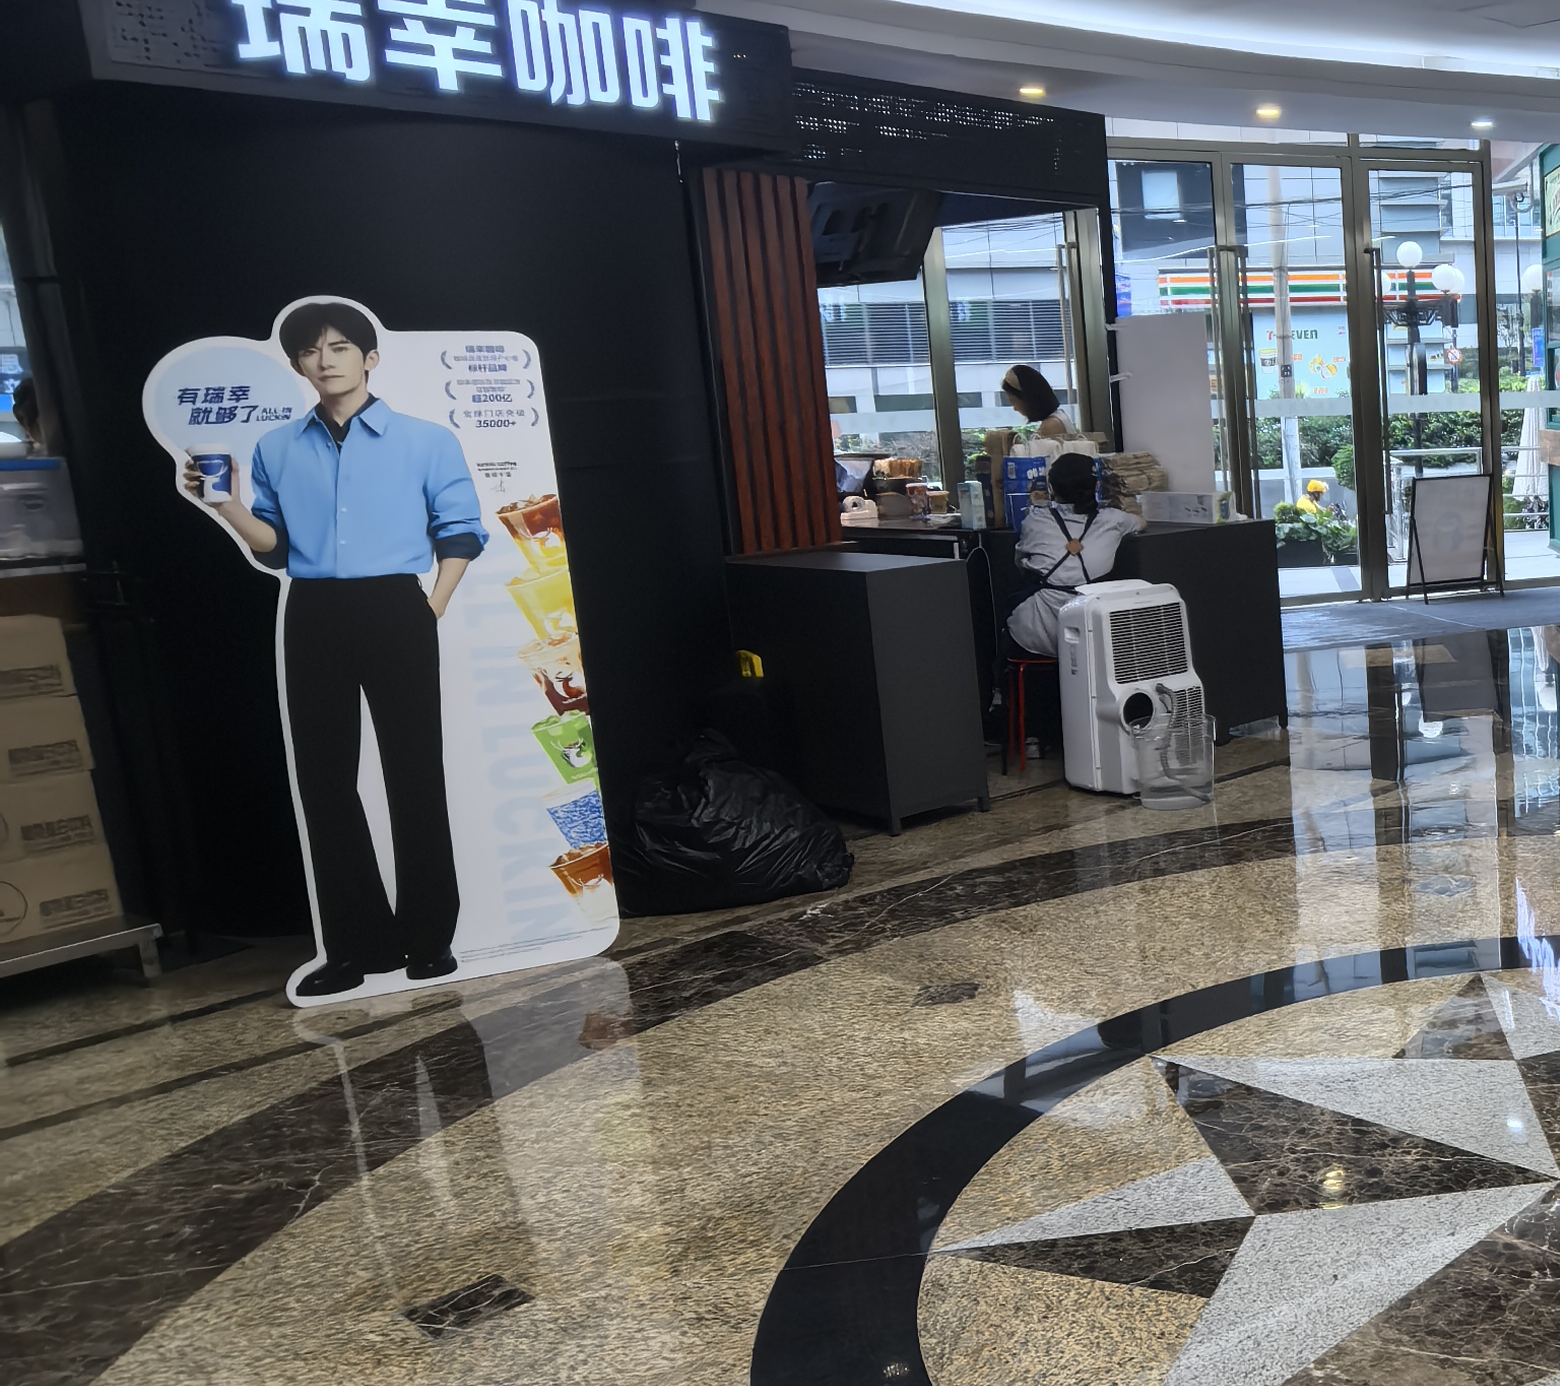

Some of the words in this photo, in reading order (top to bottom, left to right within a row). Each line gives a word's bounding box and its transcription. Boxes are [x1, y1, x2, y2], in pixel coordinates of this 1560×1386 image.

[1267, 329, 1318, 341] 7-EVEN
[177, 386, 251, 406] 有瑞幸
[188, 405, 259, 426] 就够了
